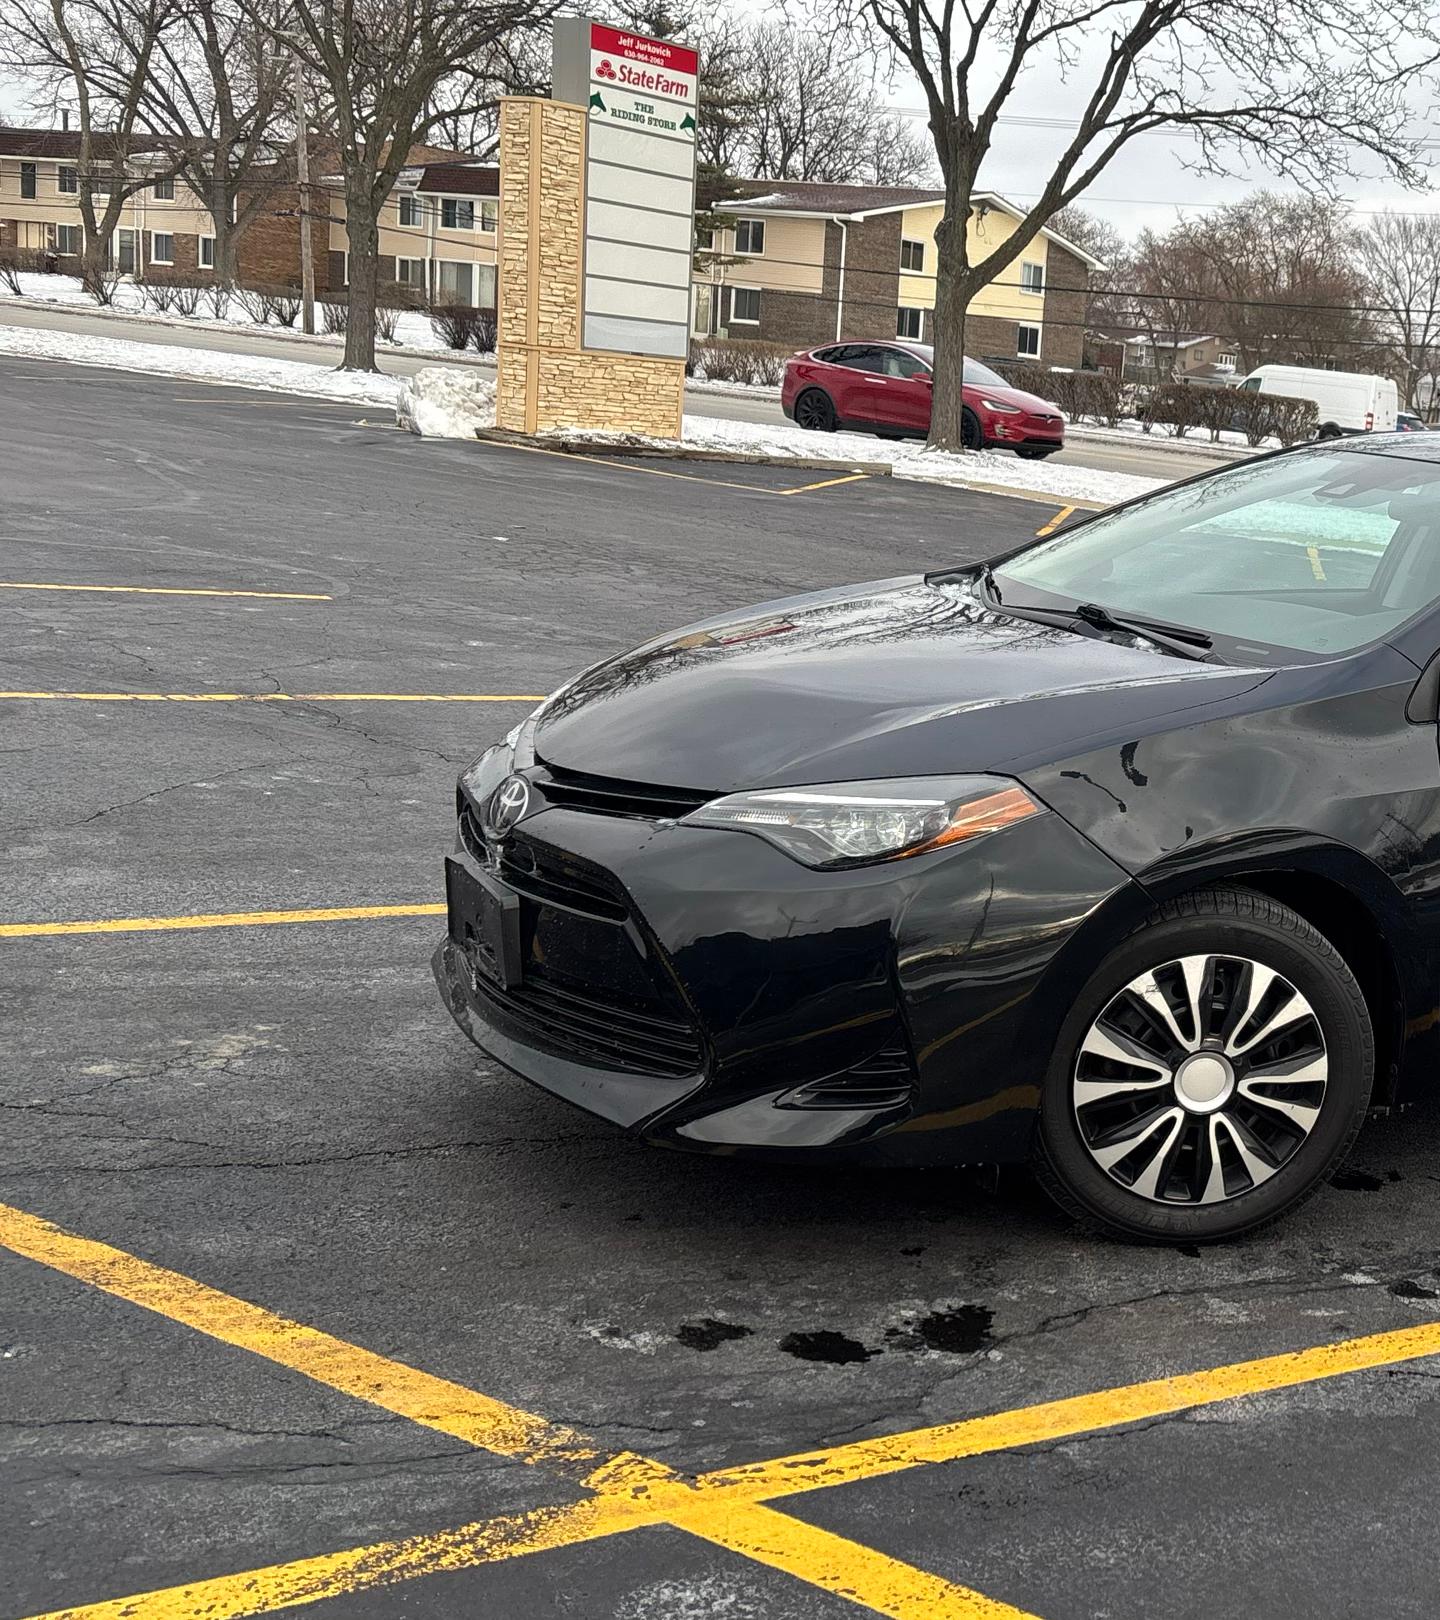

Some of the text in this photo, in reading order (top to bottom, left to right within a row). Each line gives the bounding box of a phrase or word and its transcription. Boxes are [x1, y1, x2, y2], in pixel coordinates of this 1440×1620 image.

[618, 36, 634, 47] Jeff
[634, 101, 654, 114] THE
[611, 107, 676, 131] RIDING STORE
